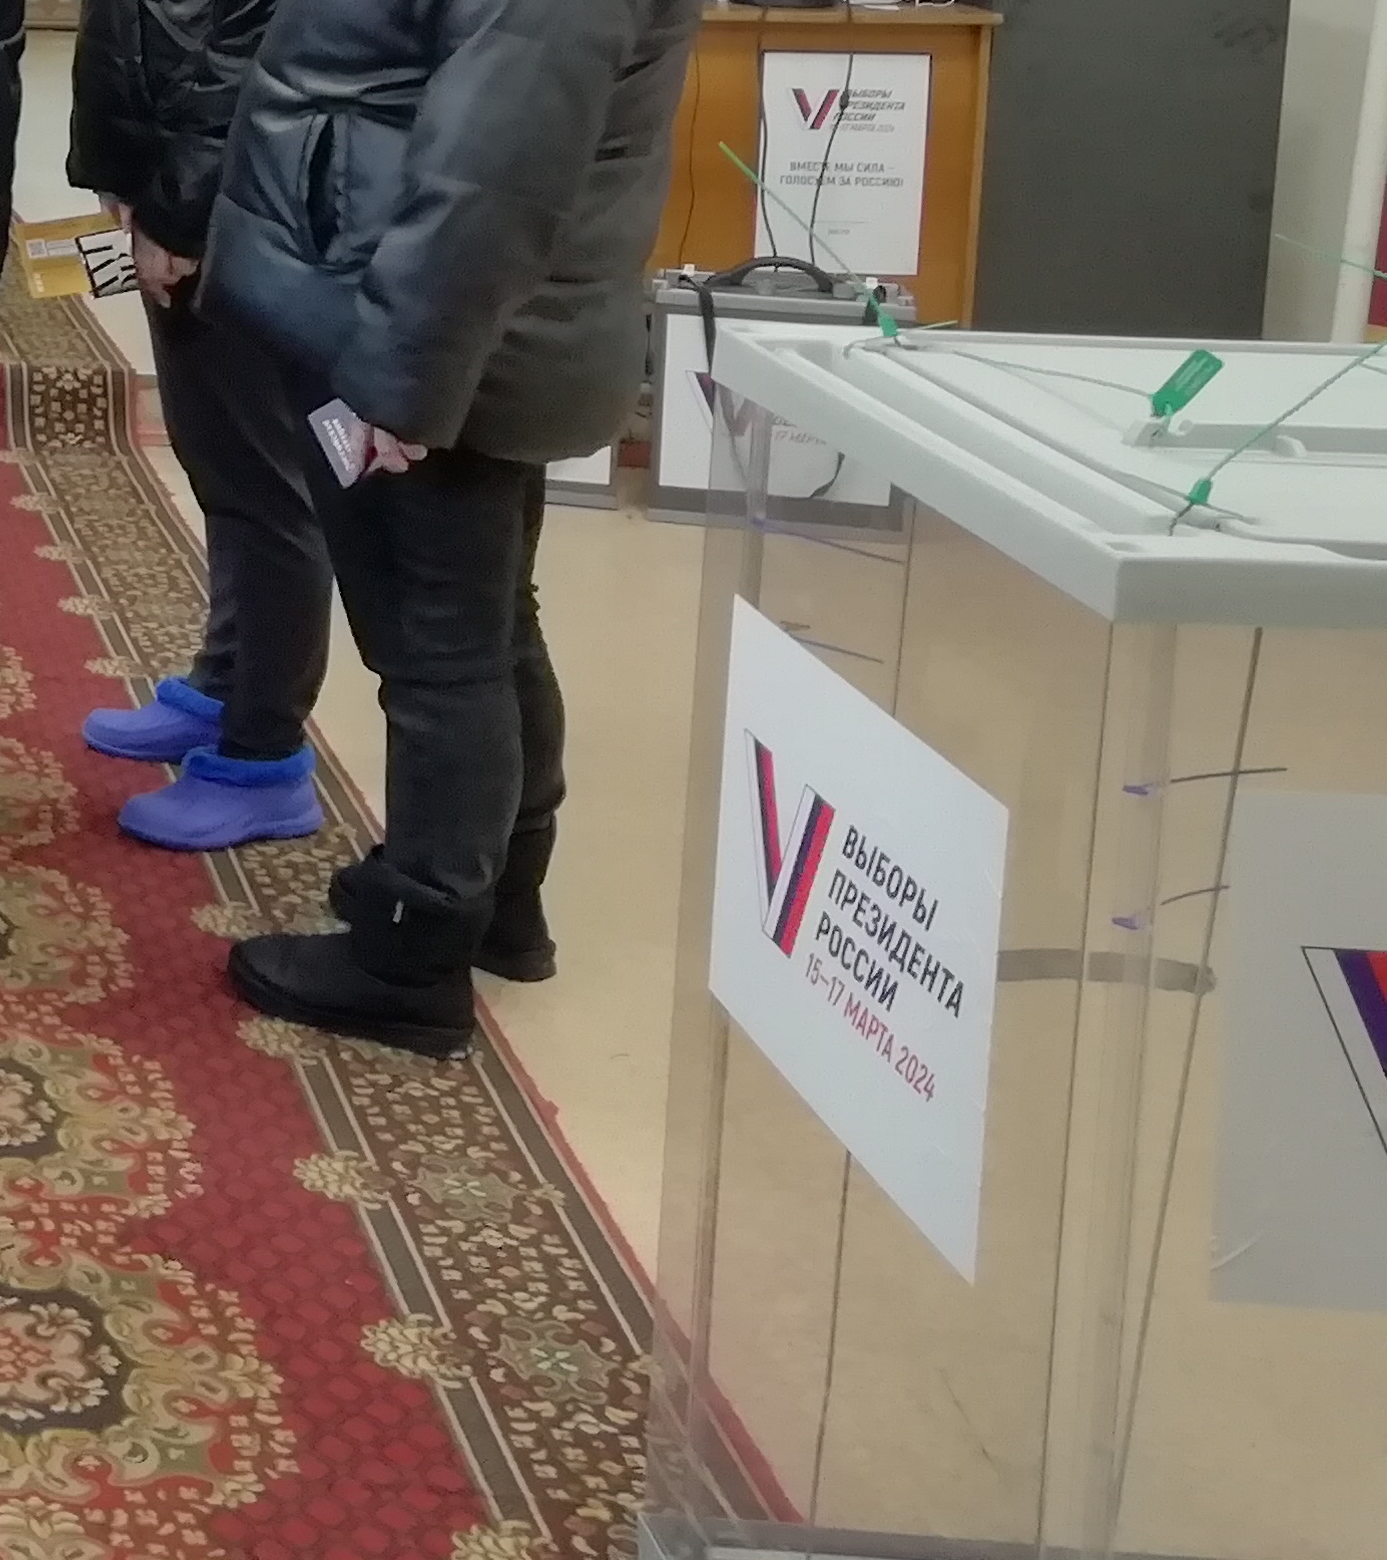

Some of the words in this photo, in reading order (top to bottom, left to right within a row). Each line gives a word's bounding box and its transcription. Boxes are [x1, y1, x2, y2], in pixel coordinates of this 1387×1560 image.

[846, 89, 893, 99] ЫБОРЫ
[847, 101, 906, 111] РЕЗИДЕНТА
[779, 175, 836, 187] ГОЛОСУМ
[841, 824, 939, 931] ВЫБОРЫ
[815, 910, 899, 1012] РОССИИ
[828, 867, 965, 1019] ПРЕЗИДЕНТА
[843, 992, 895, 1064] МАРТА
[895, 1045, 936, 1103] 2024
